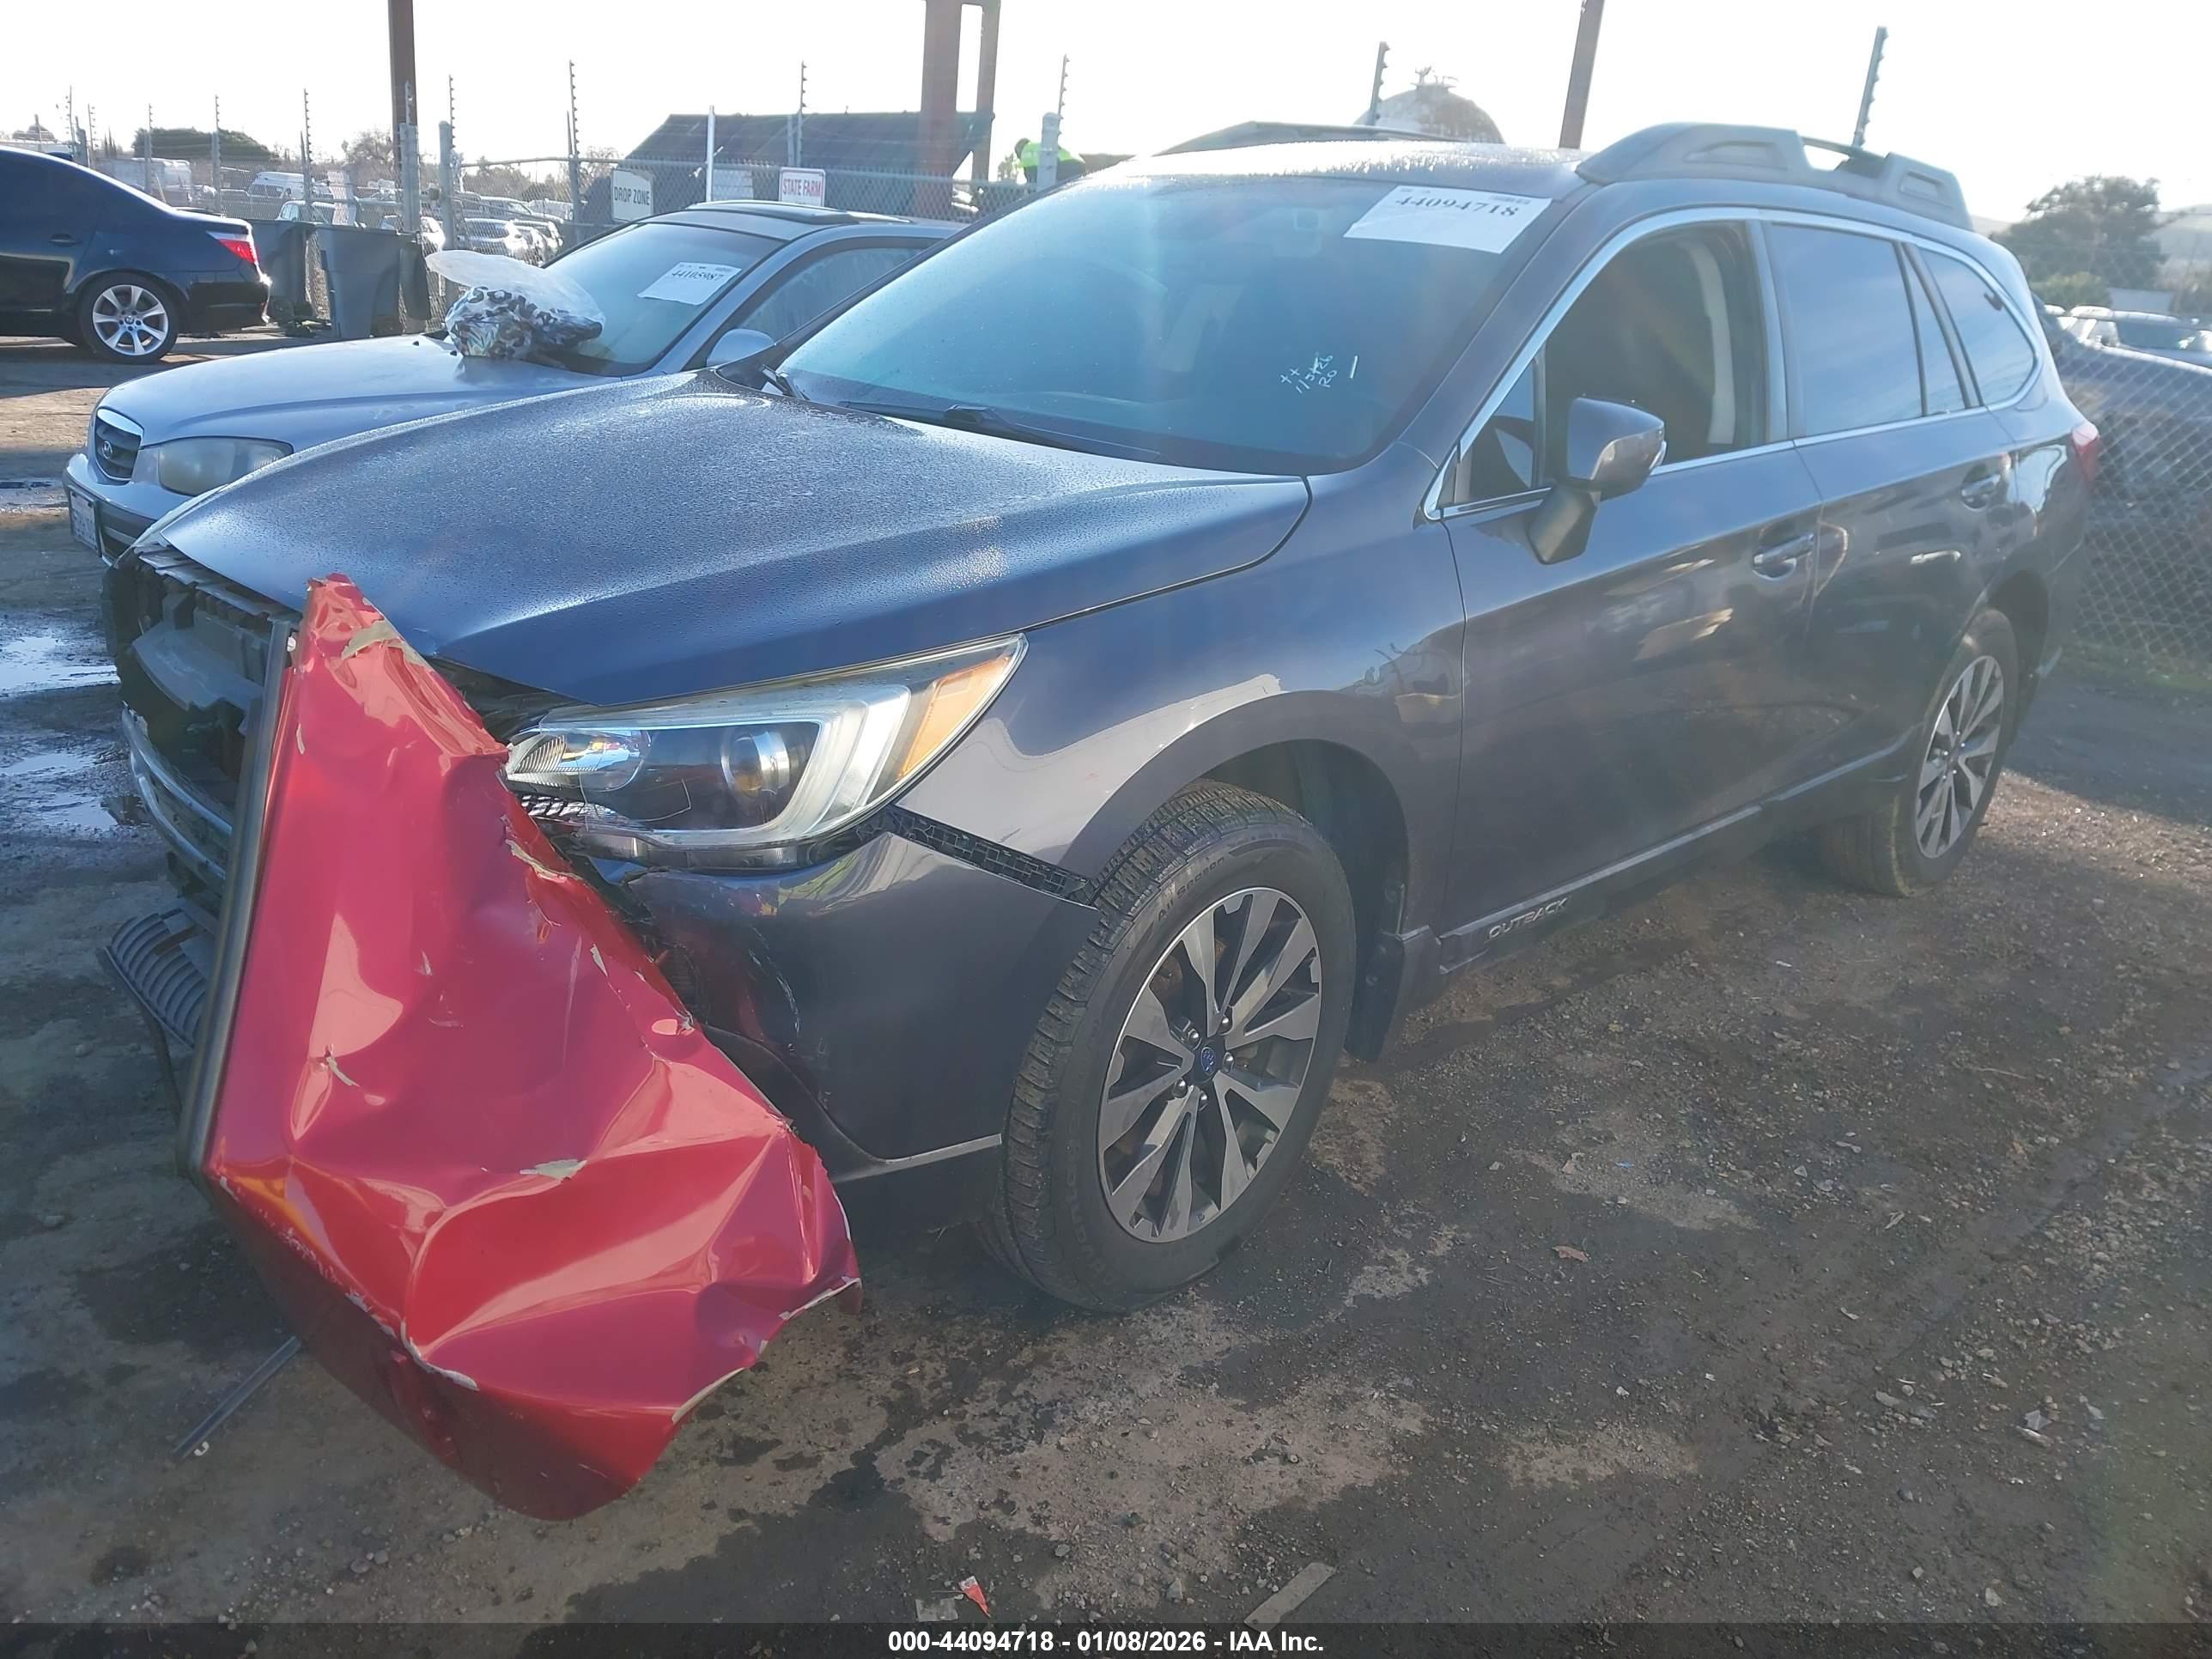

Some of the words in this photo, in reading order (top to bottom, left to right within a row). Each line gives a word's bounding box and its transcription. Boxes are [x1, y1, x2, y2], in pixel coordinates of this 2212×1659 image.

[613, 186, 632, 202] DROP
[632, 189, 651, 206] ZONE
[782, 178, 802, 196] STATE
[803, 179, 822, 198] FARM
[1395, 195, 1519, 216] 44094718
[1489, 897, 1568, 939] OUTBACK
